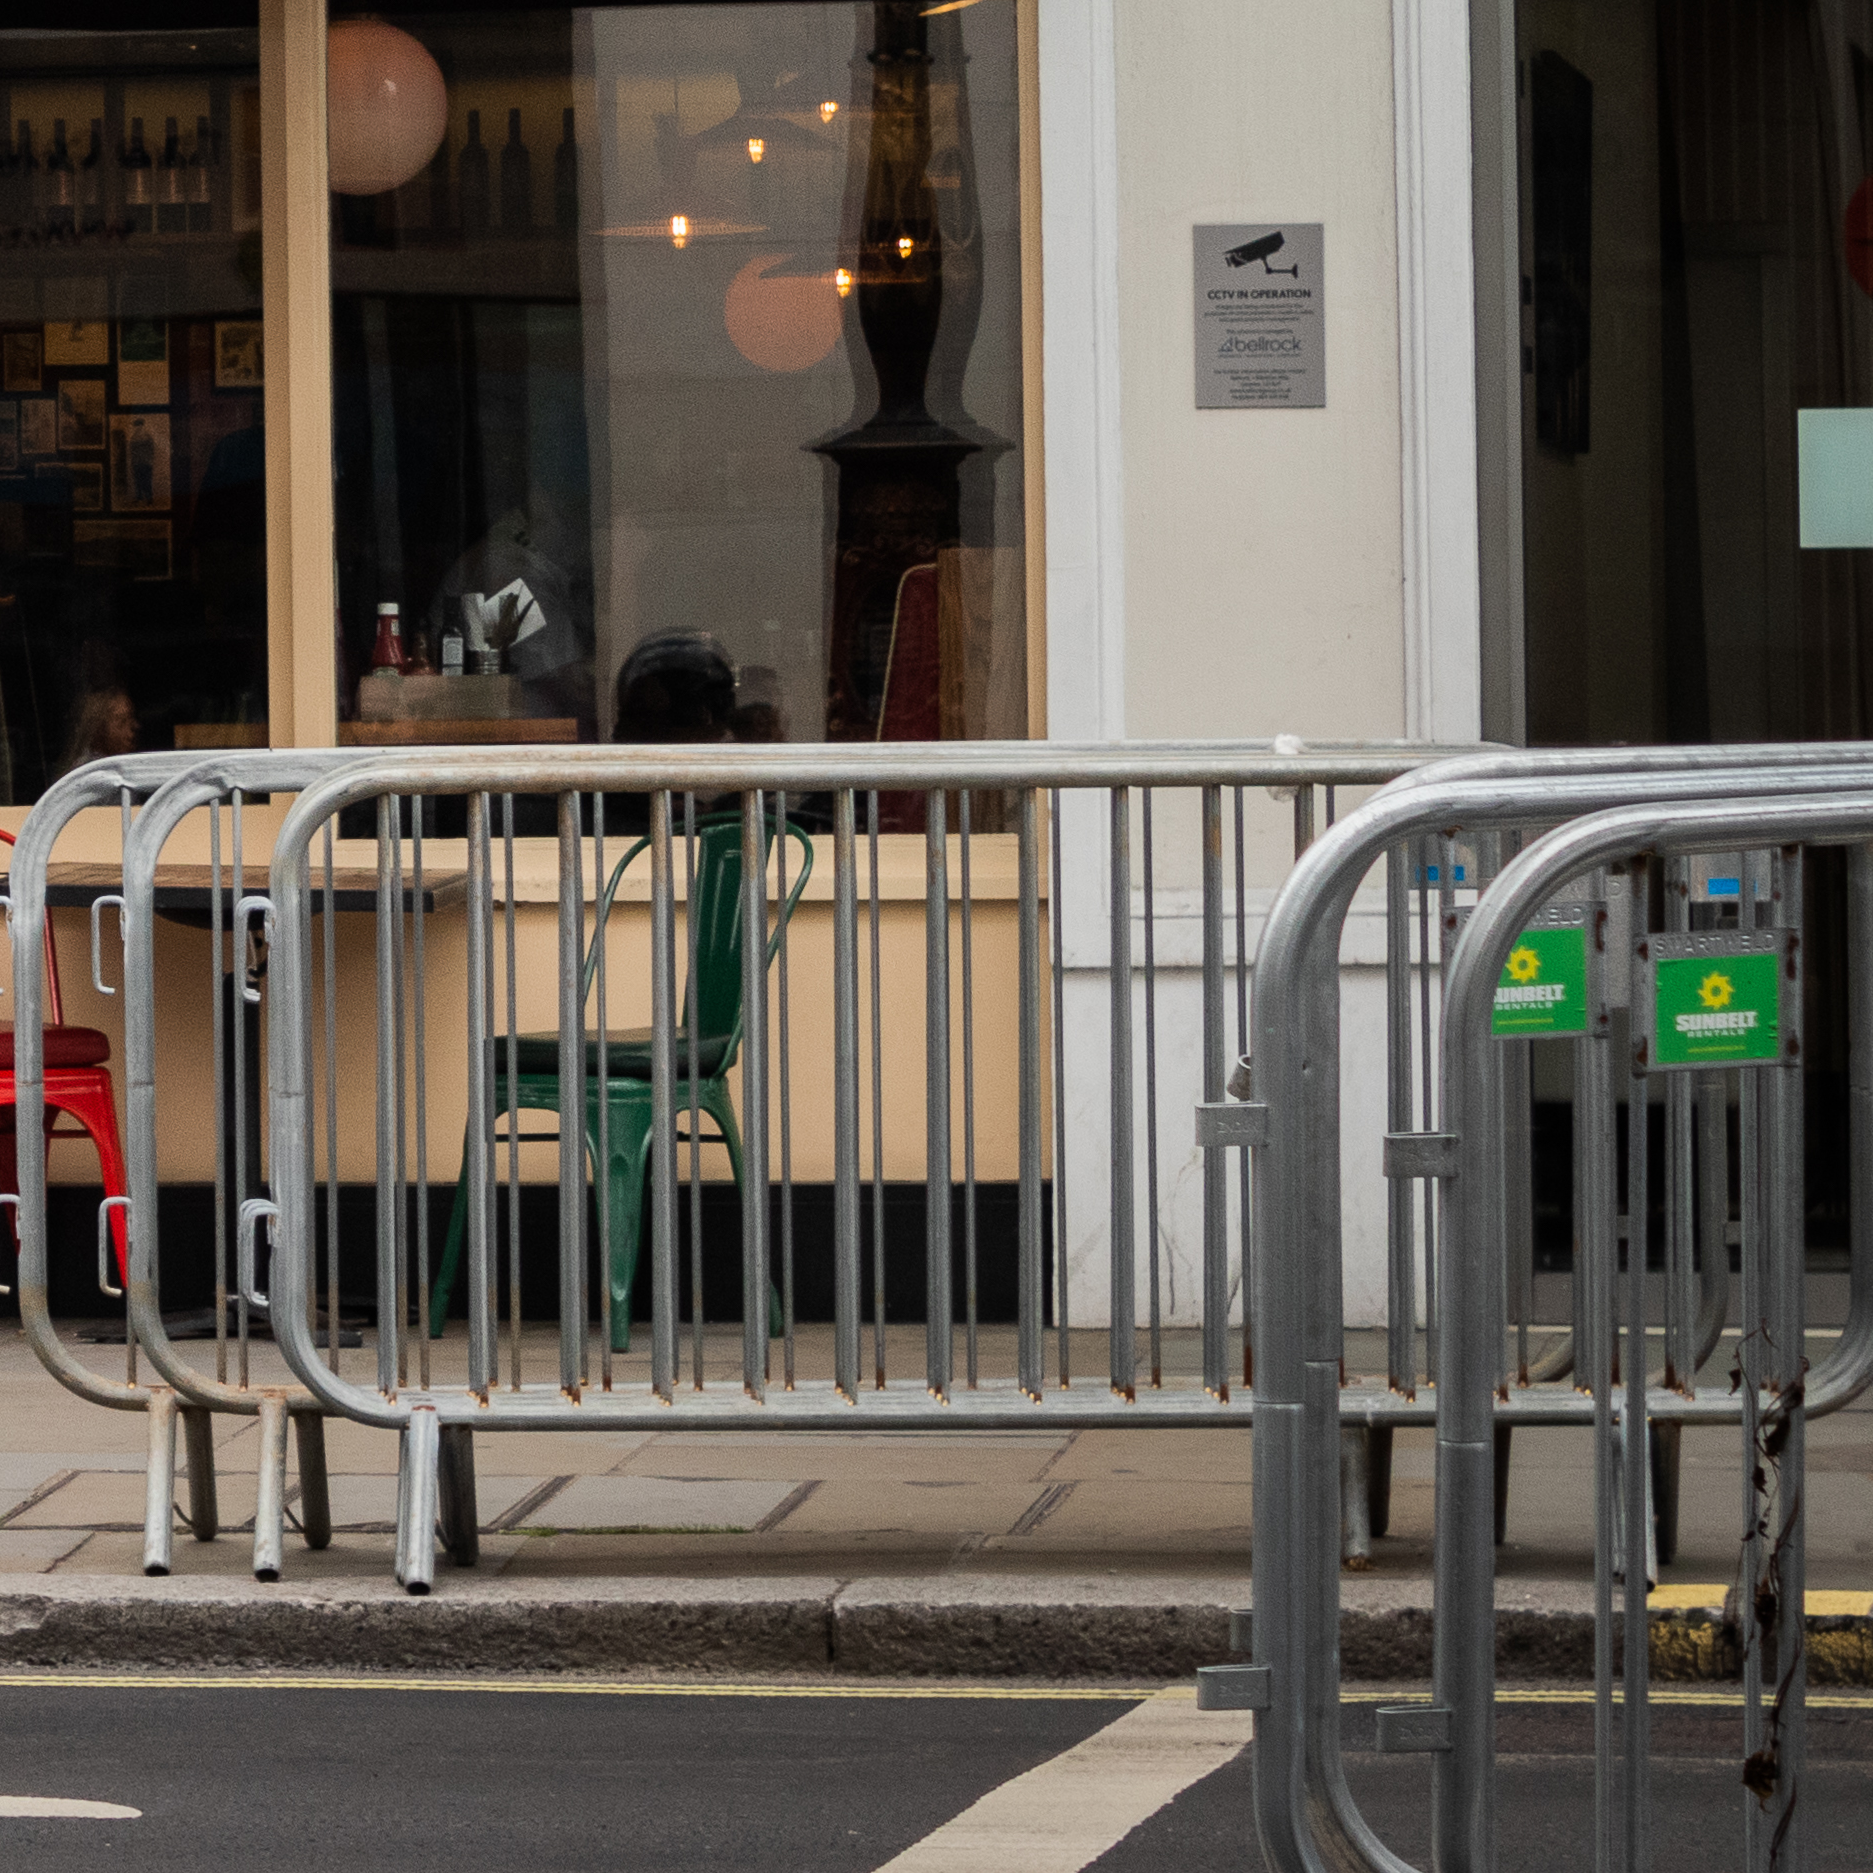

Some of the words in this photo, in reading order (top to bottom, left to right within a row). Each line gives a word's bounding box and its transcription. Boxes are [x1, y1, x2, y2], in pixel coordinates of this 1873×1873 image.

[1207, 289, 1235, 300] CCTV
[1237, 289, 1249, 299] IN
[1251, 288, 1312, 299] OPERATION
[1495, 1001, 1553, 1011] RENTALS
[1675, 1011, 1758, 1032] SUNBELT
[1687, 1028, 1746, 1038] RENTALS
